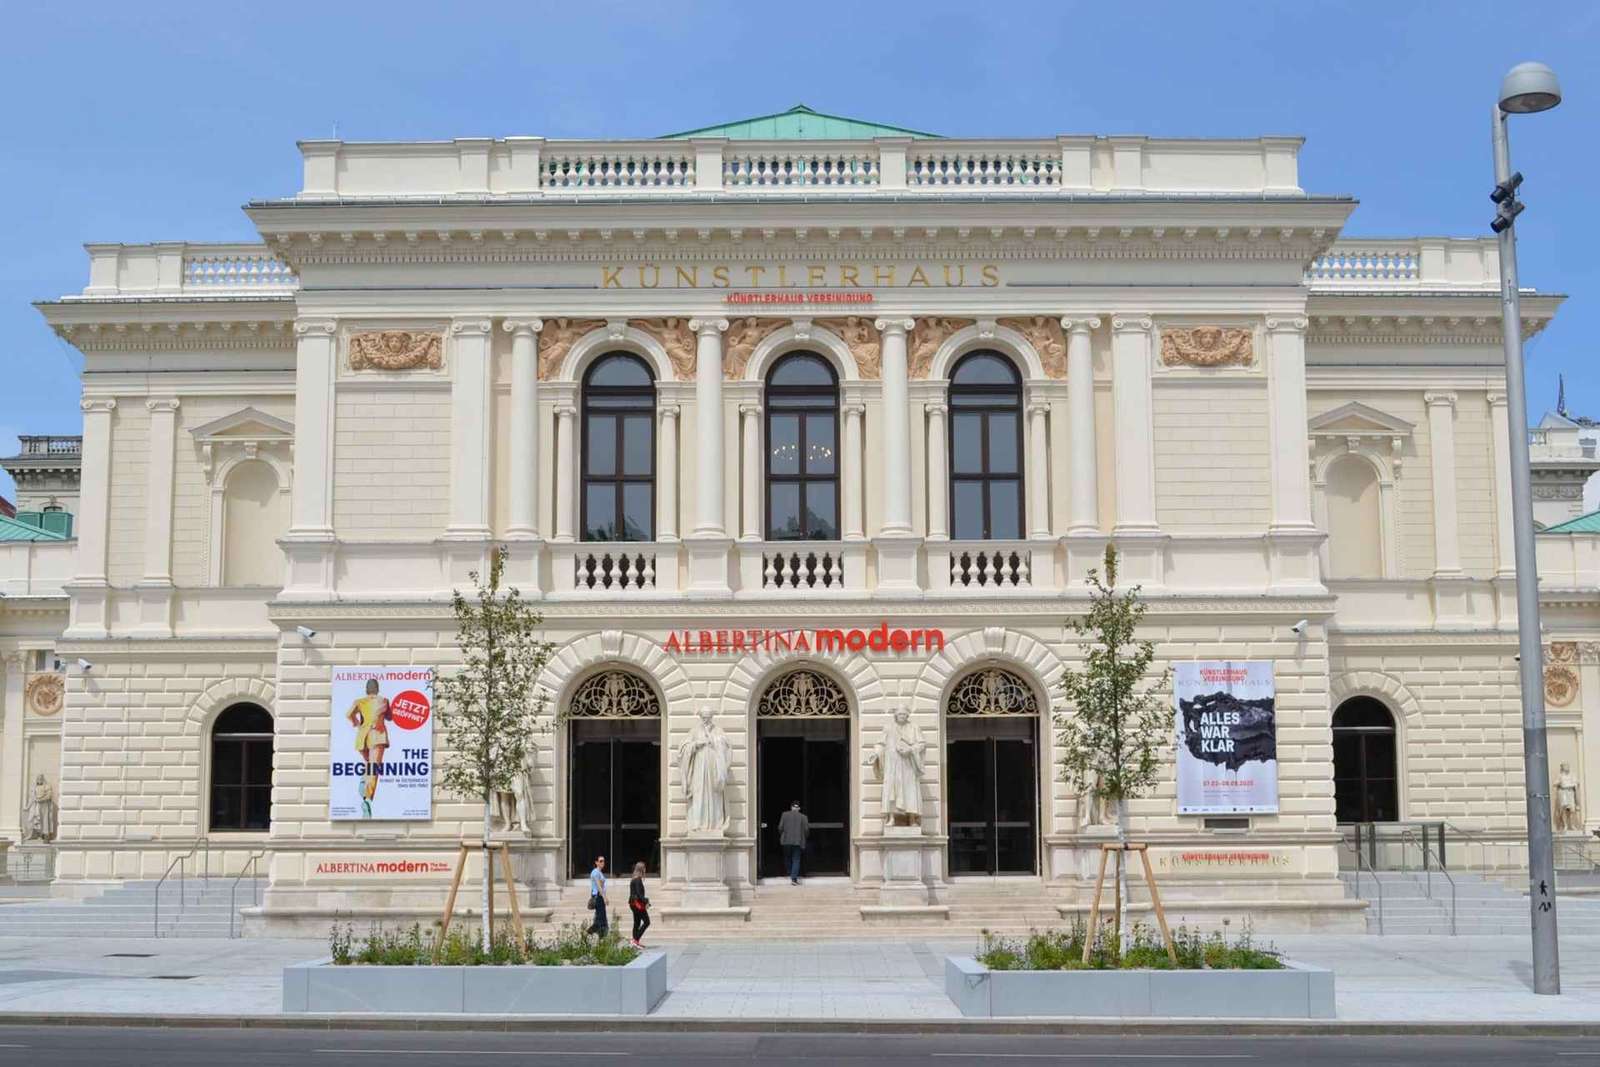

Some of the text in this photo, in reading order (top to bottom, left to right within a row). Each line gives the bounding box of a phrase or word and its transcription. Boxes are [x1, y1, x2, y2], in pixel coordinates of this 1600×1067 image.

[602, 263, 1000, 288] KÜNSTLERHAUS
[727, 292, 804, 304] KÜNSTLERHAUS
[664, 620, 945, 654] ALBERTINA modern
[335, 670, 431, 681] ALBERTINA modern
[395, 698, 429, 715] JETZT
[1200, 712, 1240, 725] ALLES
[1201, 726, 1230, 738] WAR
[1201, 740, 1235, 753] KLAR
[402, 749, 429, 760] THE
[332, 762, 429, 776] BEGINNING
[316, 863, 376, 873] ALBERTINA
[377, 860, 429, 872] modern
